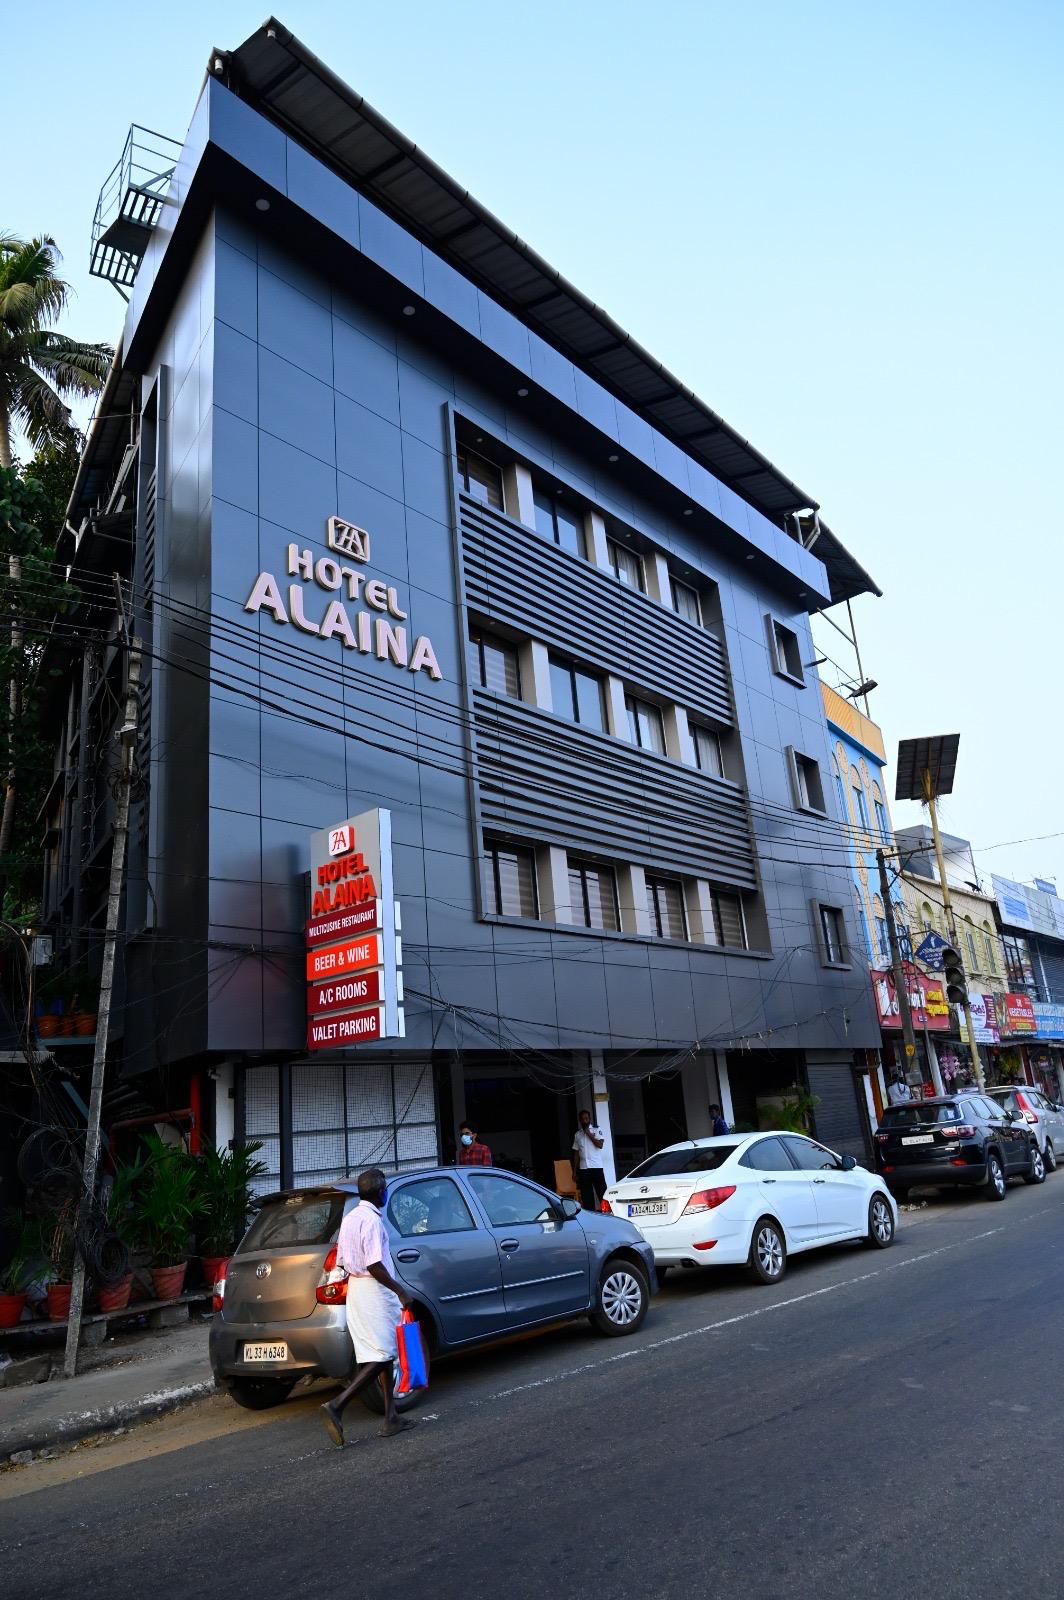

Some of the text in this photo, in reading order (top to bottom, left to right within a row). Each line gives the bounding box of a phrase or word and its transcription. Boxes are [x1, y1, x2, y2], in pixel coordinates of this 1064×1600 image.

[288, 543, 408, 620] HOTEL
[244, 572, 443, 680] ALAINA
[318, 852, 369, 885] HOTEL
[312, 874, 377, 915] ALAINA
[342, 908, 375, 929] RESTAURANT
[314, 944, 370, 972] BEER & WINE
[319, 980, 368, 1006] A/C ROOMS
[312, 1015, 376, 1042] VALET PARKING
[254, 1347, 262, 1359] 33
[269, 1346, 285, 1359] 6348
